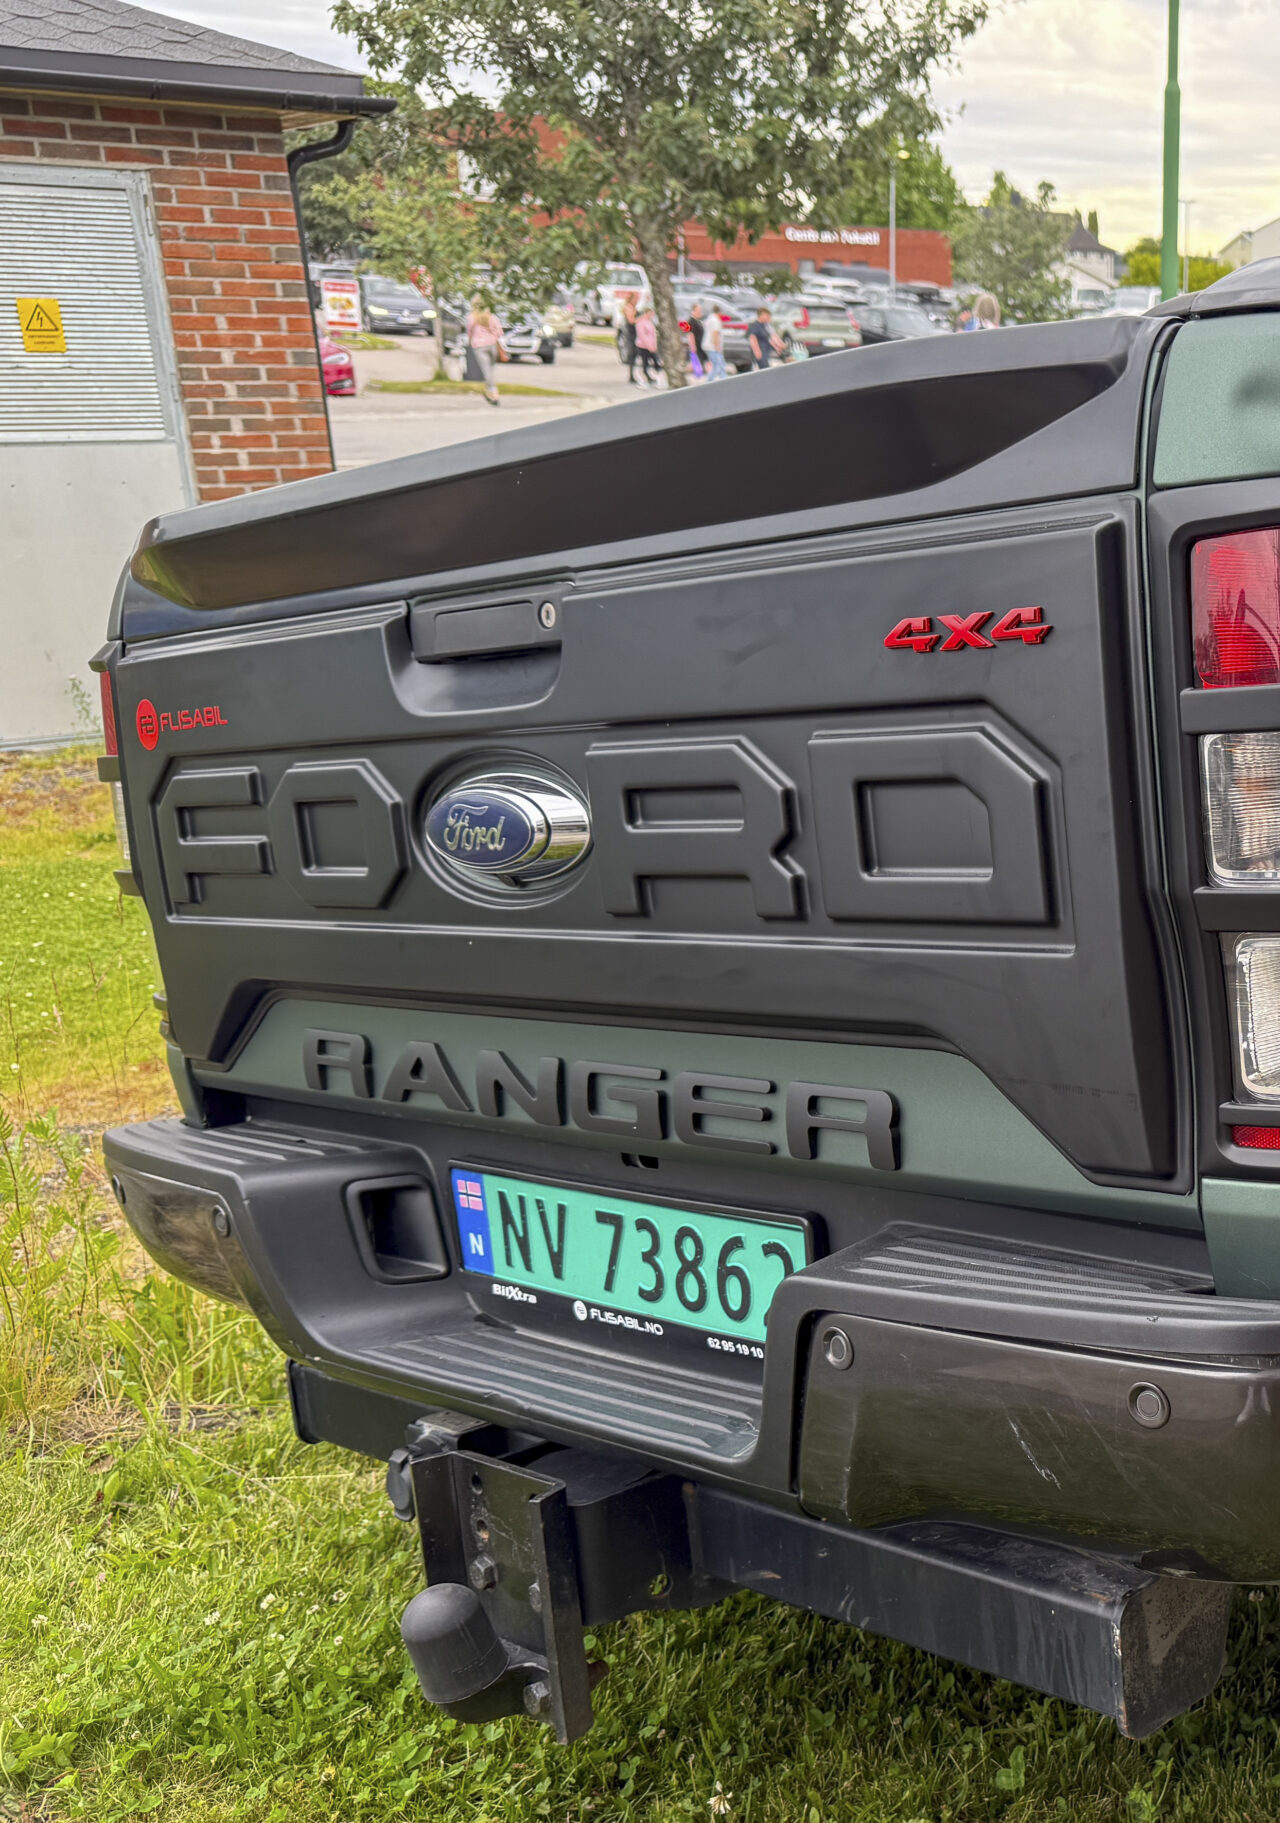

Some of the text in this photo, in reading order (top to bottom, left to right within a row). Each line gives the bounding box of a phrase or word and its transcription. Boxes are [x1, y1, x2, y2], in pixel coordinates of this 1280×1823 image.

[160, 705, 229, 732] FLISABIL
[443, 803, 506, 851] Ford
[303, 1028, 902, 1171] RANGER
[469, 1233, 485, 1256] N
[497, 1189, 568, 1280] NV
[491, 1283, 538, 1304] BilXtra
[589, 1307, 664, 1336] FLISABIL.NO
[706, 1336, 722, 1350] 62
[736, 1343, 750, 1356] 19
[750, 1346, 764, 1359] 10
